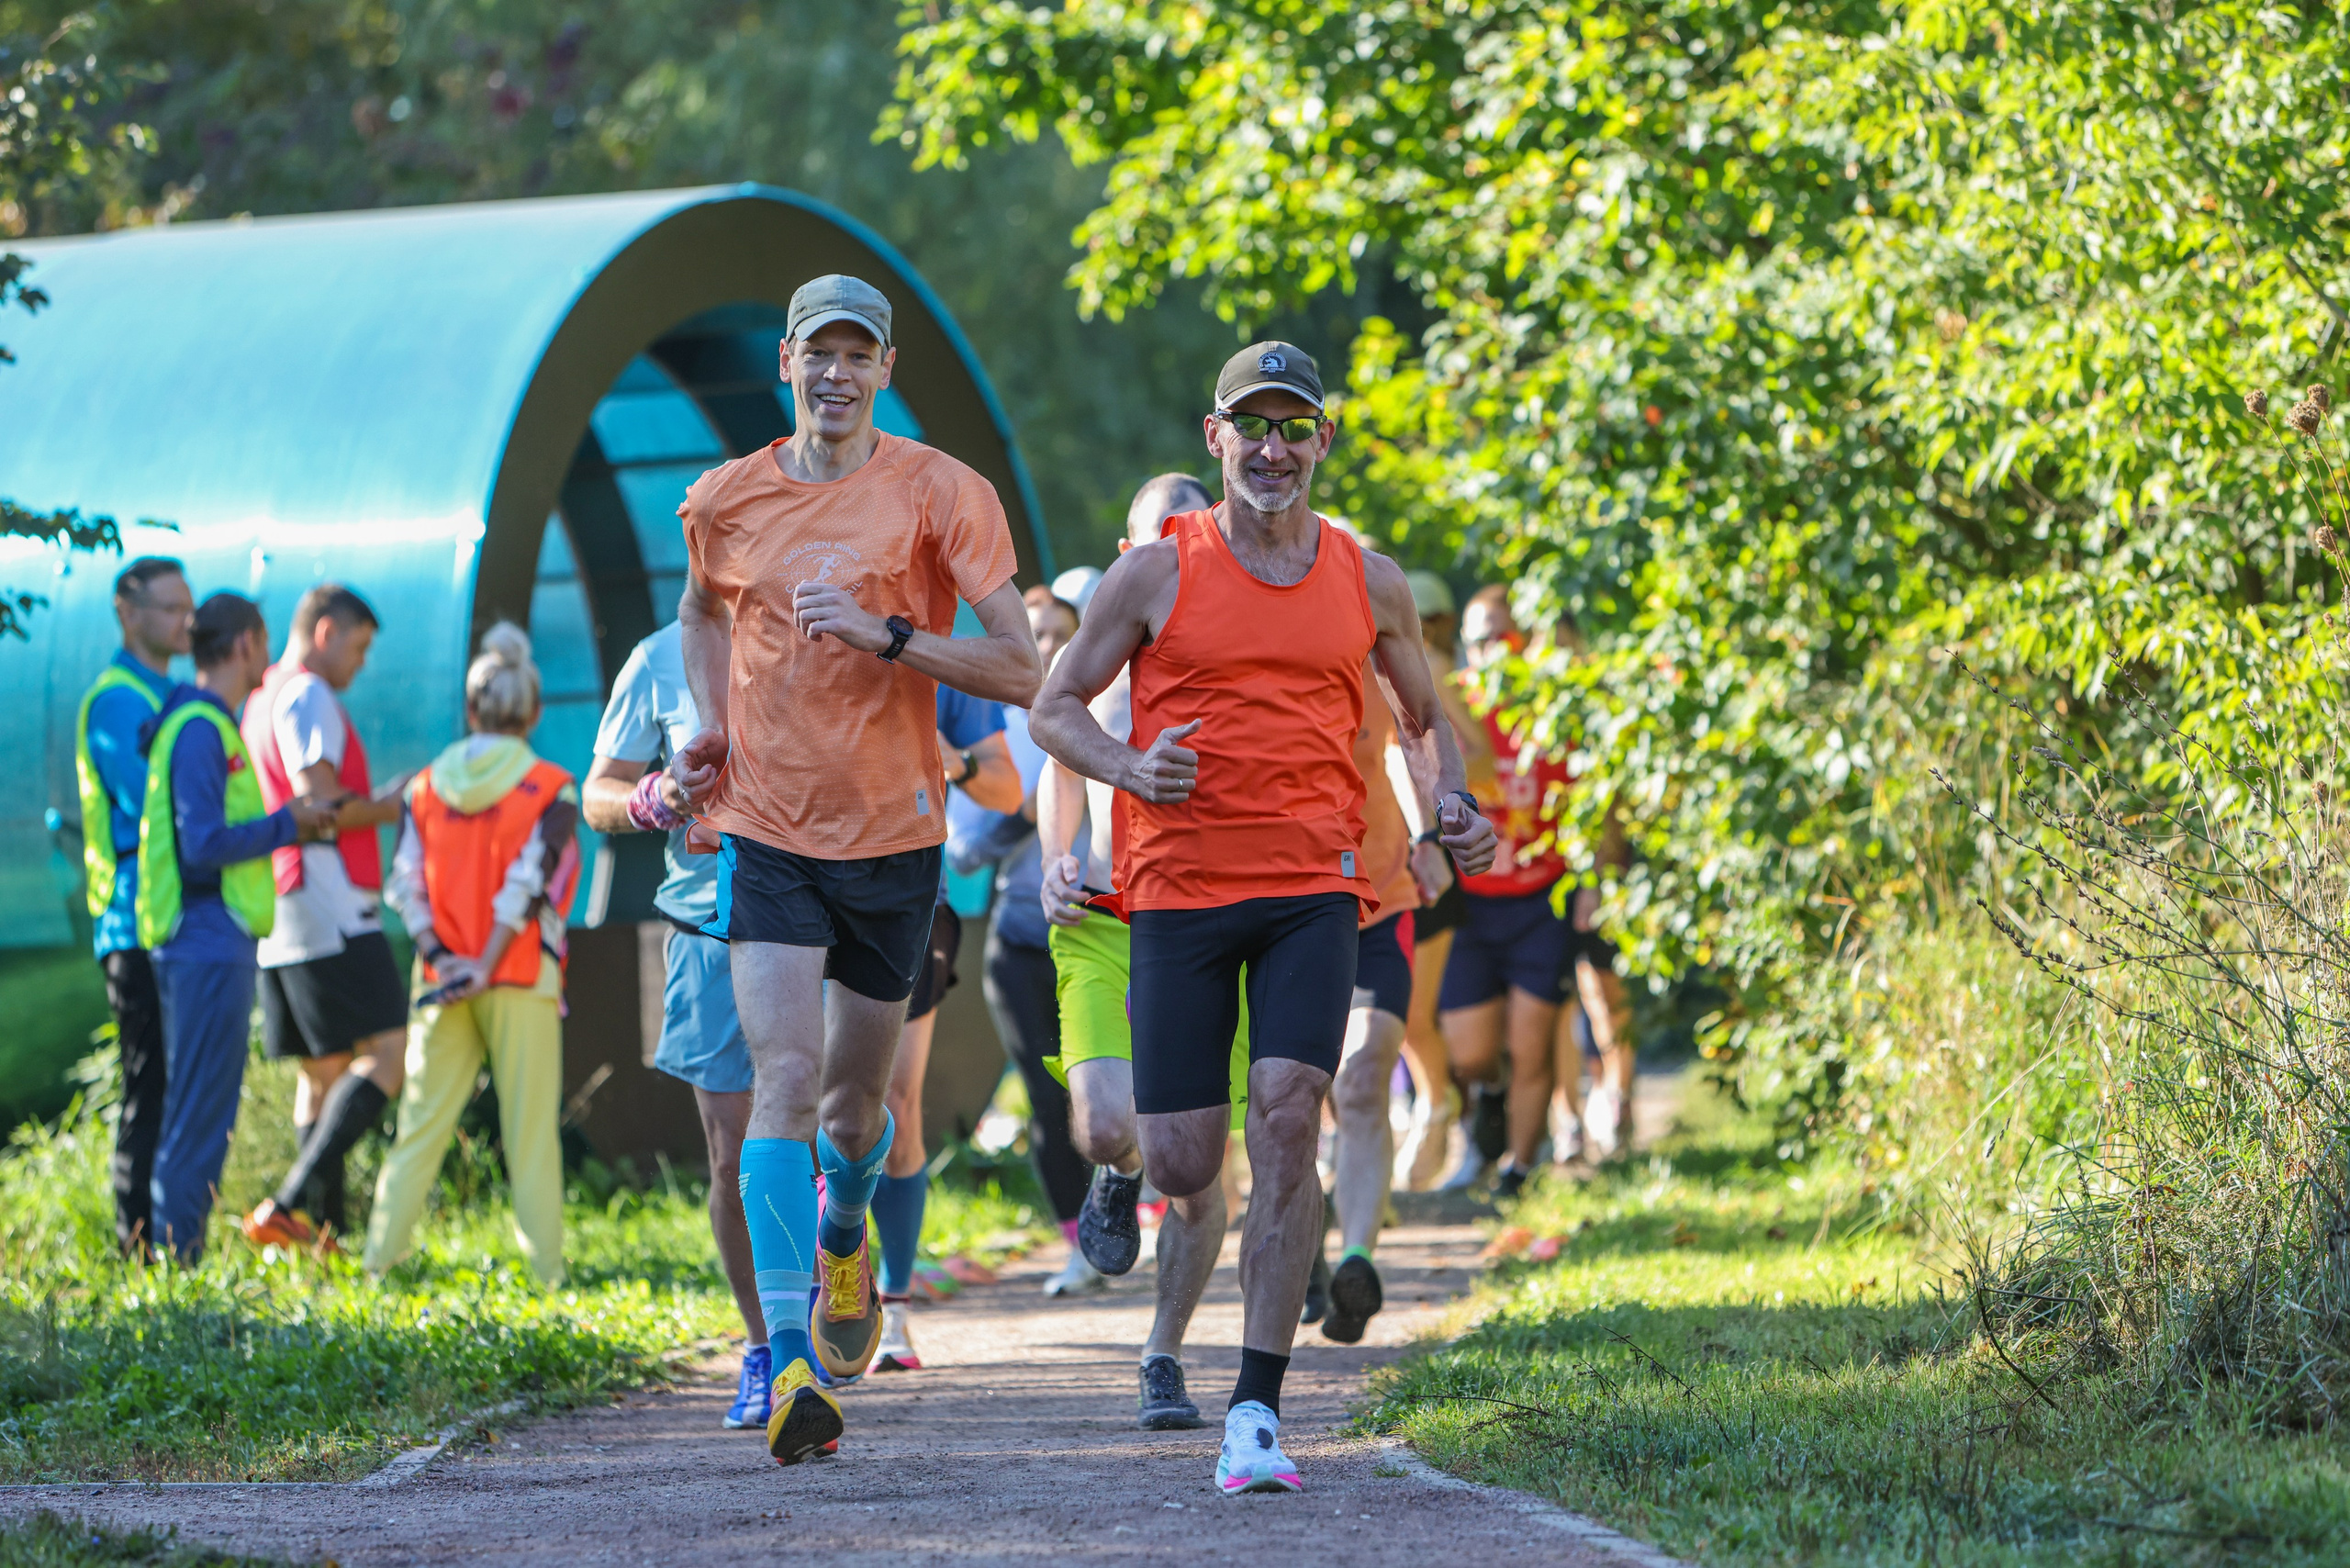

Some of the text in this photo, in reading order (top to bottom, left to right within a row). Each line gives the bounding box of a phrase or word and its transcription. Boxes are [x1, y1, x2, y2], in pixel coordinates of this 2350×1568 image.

[783, 541, 861, 566] GOLDEN RING
[845, 581, 863, 595] AIL
